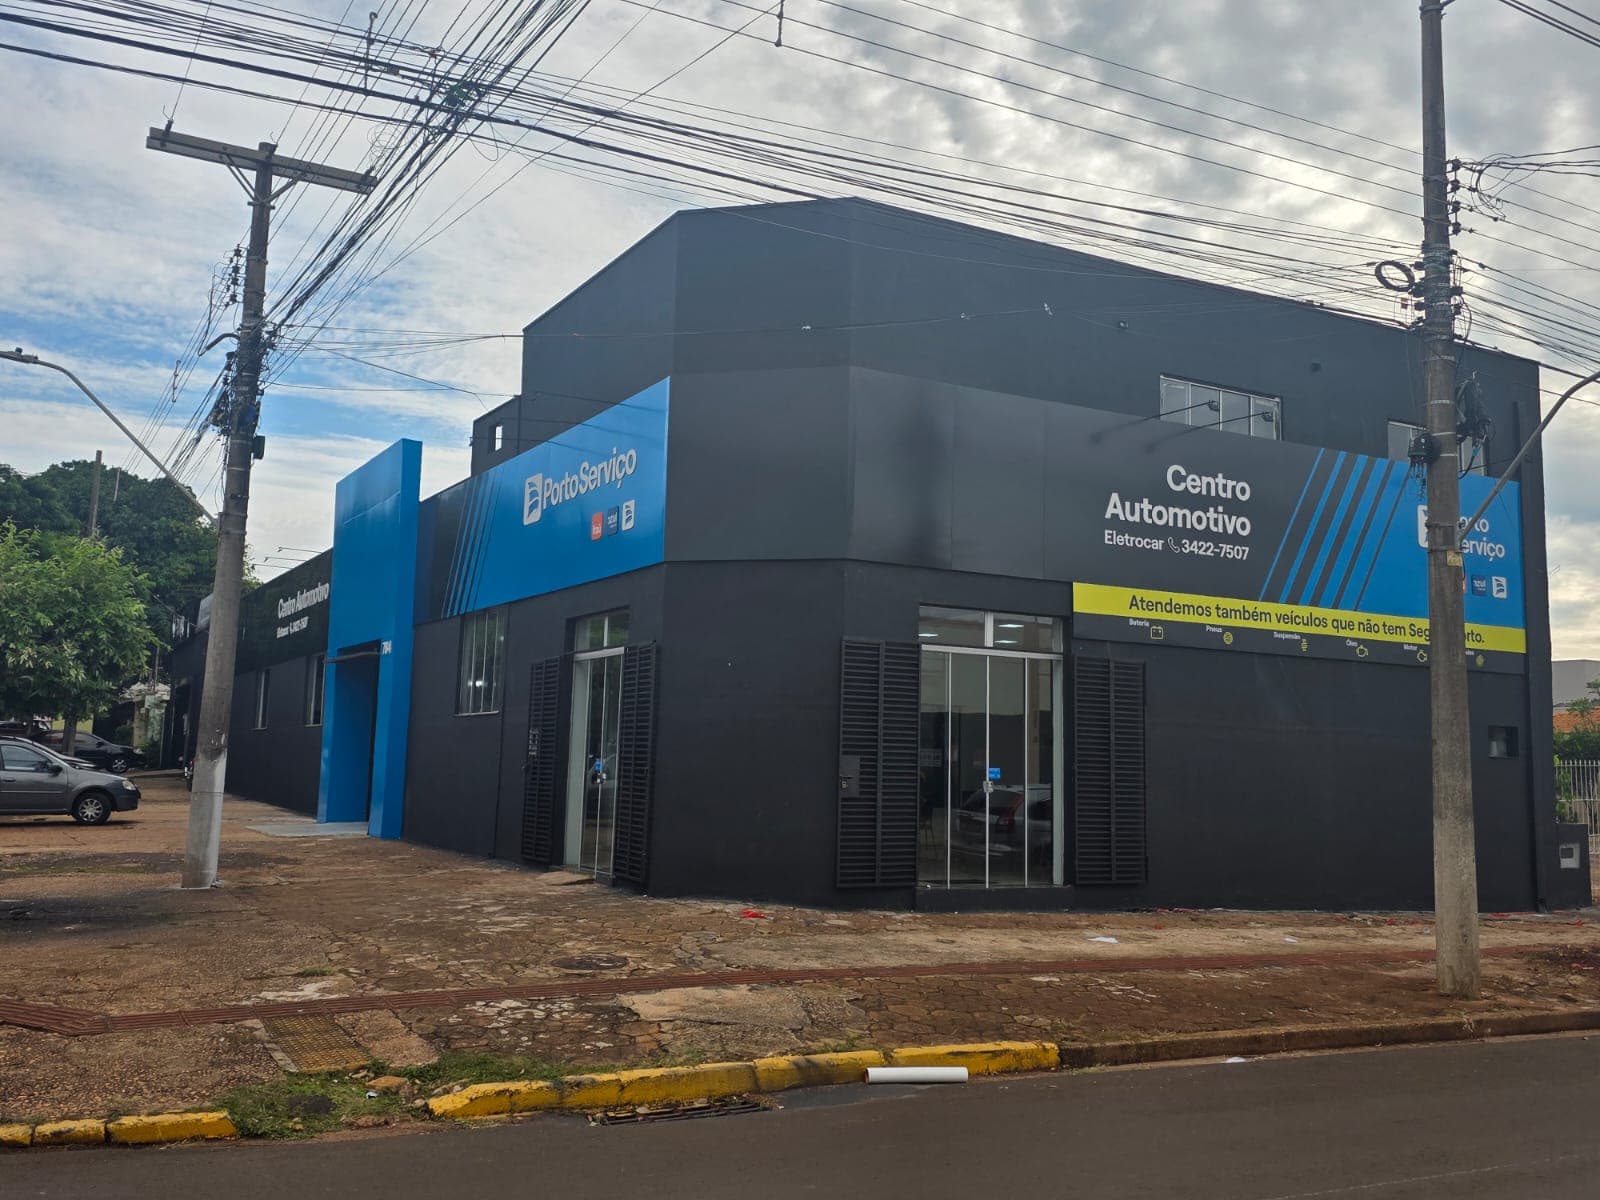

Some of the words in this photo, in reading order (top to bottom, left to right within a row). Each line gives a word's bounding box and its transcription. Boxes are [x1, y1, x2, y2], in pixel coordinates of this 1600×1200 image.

[1166, 464, 1251, 501] Centro
[1104, 492, 1251, 536] Automotivo
[1104, 529, 1165, 551] Eletrocar
[1181, 539, 1250, 561] 3422-7507
[1460, 536, 1506, 562] erviço
[1128, 594, 1212, 617] Atendemos
[1215, 603, 1272, 623] também
[1275, 609, 1328, 628] veículos
[1331, 617, 1355, 634] que
[1358, 618, 1380, 634] não
[1382, 622, 1406, 636] tem
[1408, 623, 1431, 641] Seg
[1464, 629, 1485, 644] rto.
